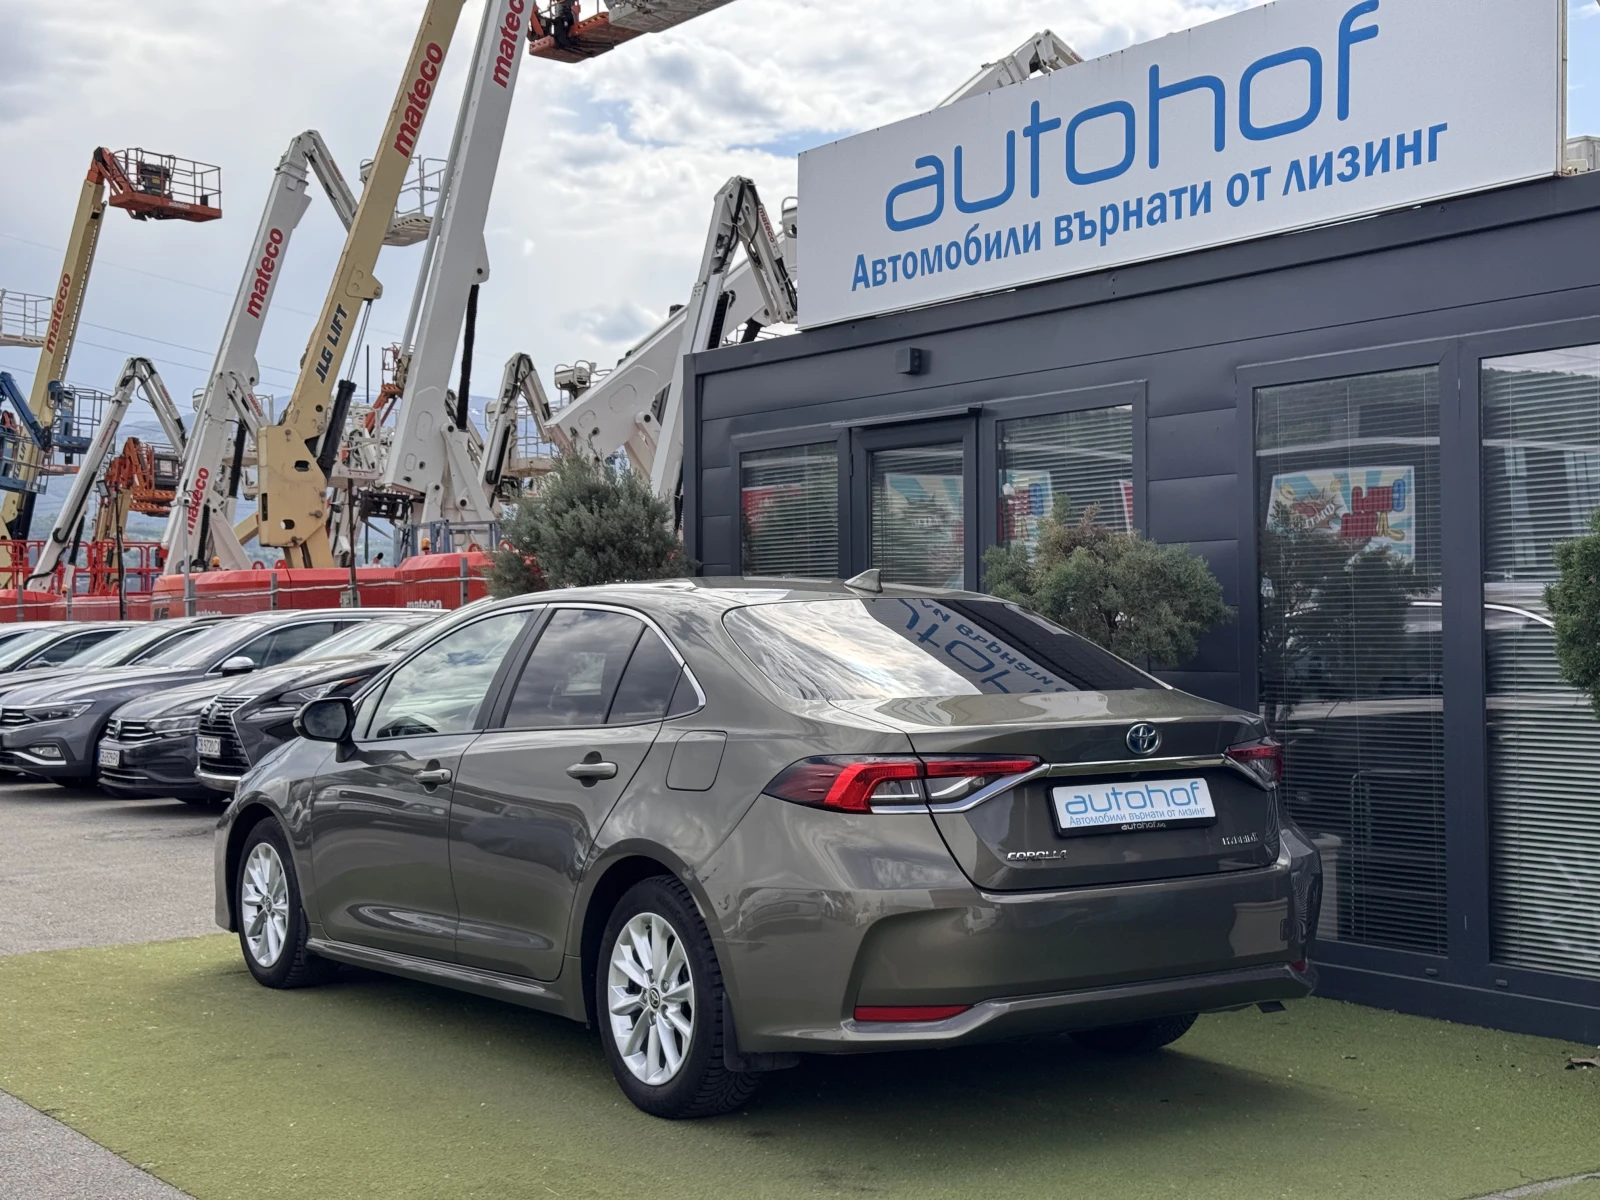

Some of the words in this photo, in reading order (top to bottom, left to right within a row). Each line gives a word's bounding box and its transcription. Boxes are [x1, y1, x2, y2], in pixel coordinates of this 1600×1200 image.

[493, 0, 524, 88] matec
[394, 43, 443, 157] mateco
[886, 0, 1379, 231] autohof
[758, 207, 775, 243] mateco
[852, 222, 1041, 291] Автомобили
[1055, 181, 1212, 246] върнати
[1227, 167, 1272, 208] от
[1283, 123, 1448, 195] лизинг
[46, 273, 71, 354] mateco
[247, 228, 283, 318] mateco
[315, 345, 334, 384] JLG
[326, 303, 348, 348] LIFT
[187, 467, 210, 536] mateco
[1064, 781, 1200, 815] autohof
[1069, 811, 1127, 826] Автомобили
[1129, 809, 1165, 821] върнати
[1167, 809, 1177, 817] от
[1178, 807, 1206, 817] лизинг
[1006, 849, 1068, 861] COROLLA
